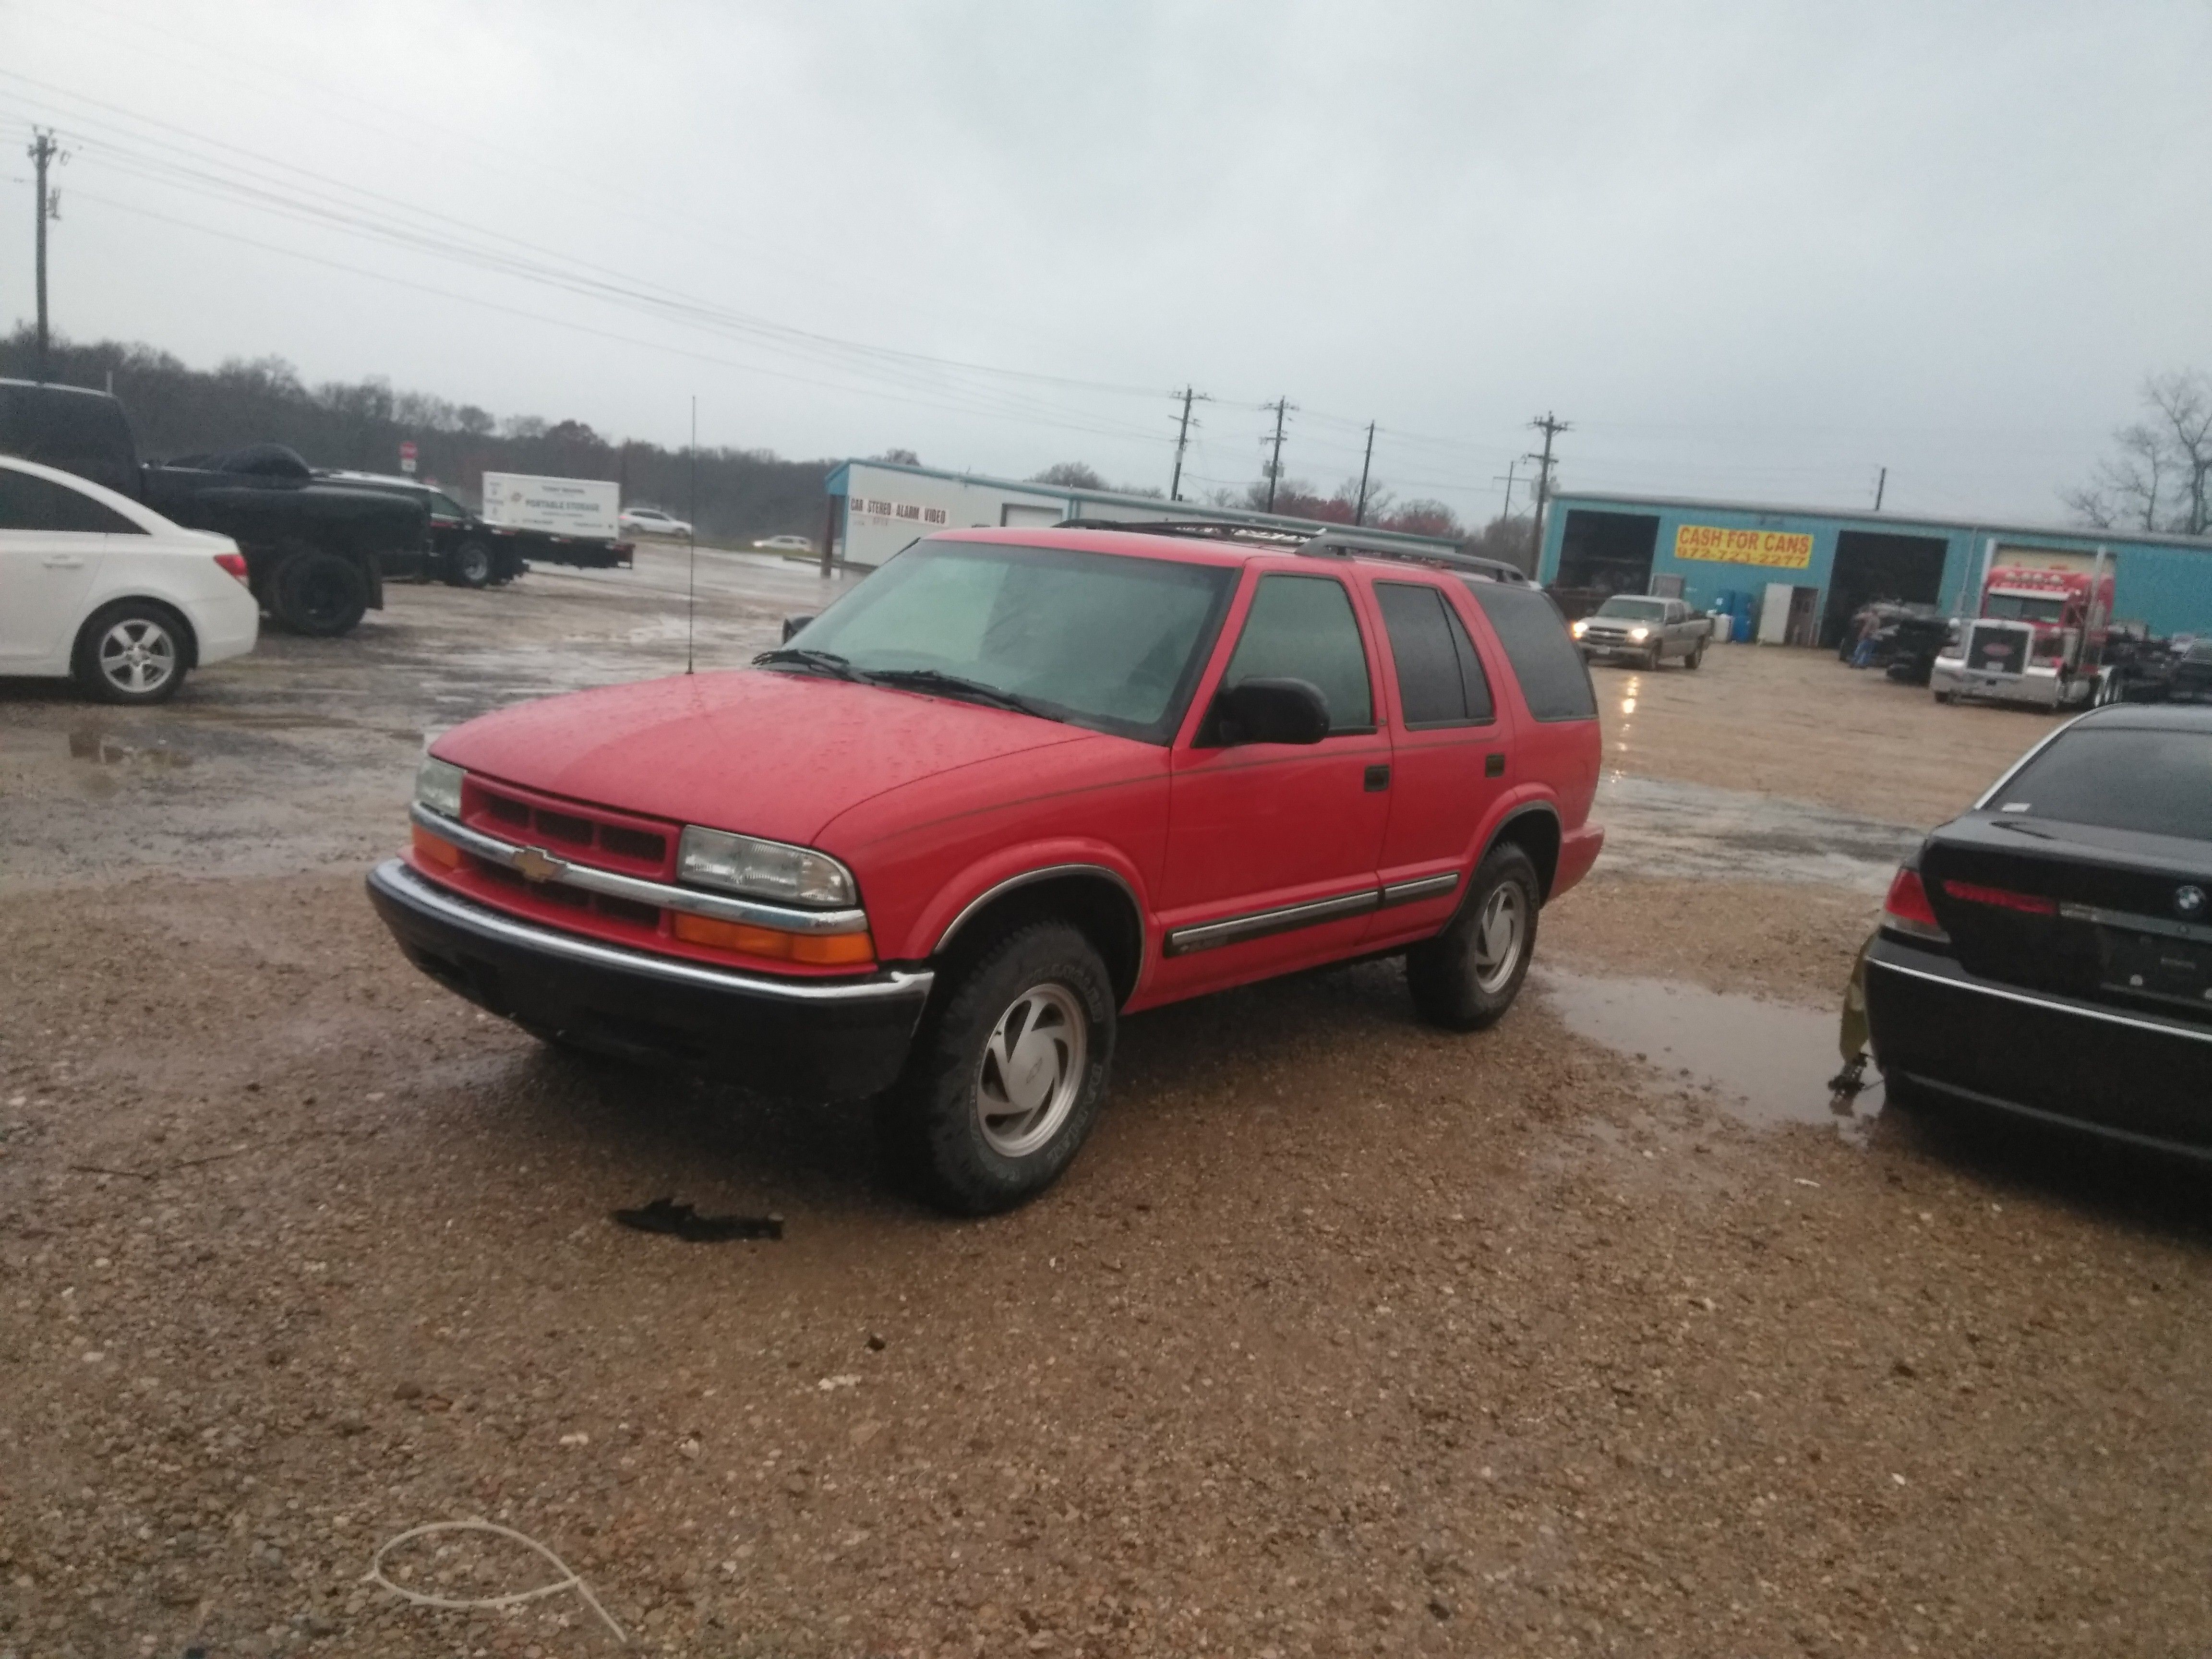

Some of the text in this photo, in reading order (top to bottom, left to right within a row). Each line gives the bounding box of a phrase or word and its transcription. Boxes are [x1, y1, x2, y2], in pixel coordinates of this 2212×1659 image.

[851, 498, 946, 525] CAR STEREO ALARM VIDEO
[1679, 527, 1722, 548] CASH
[1726, 530, 1760, 550] FOR
